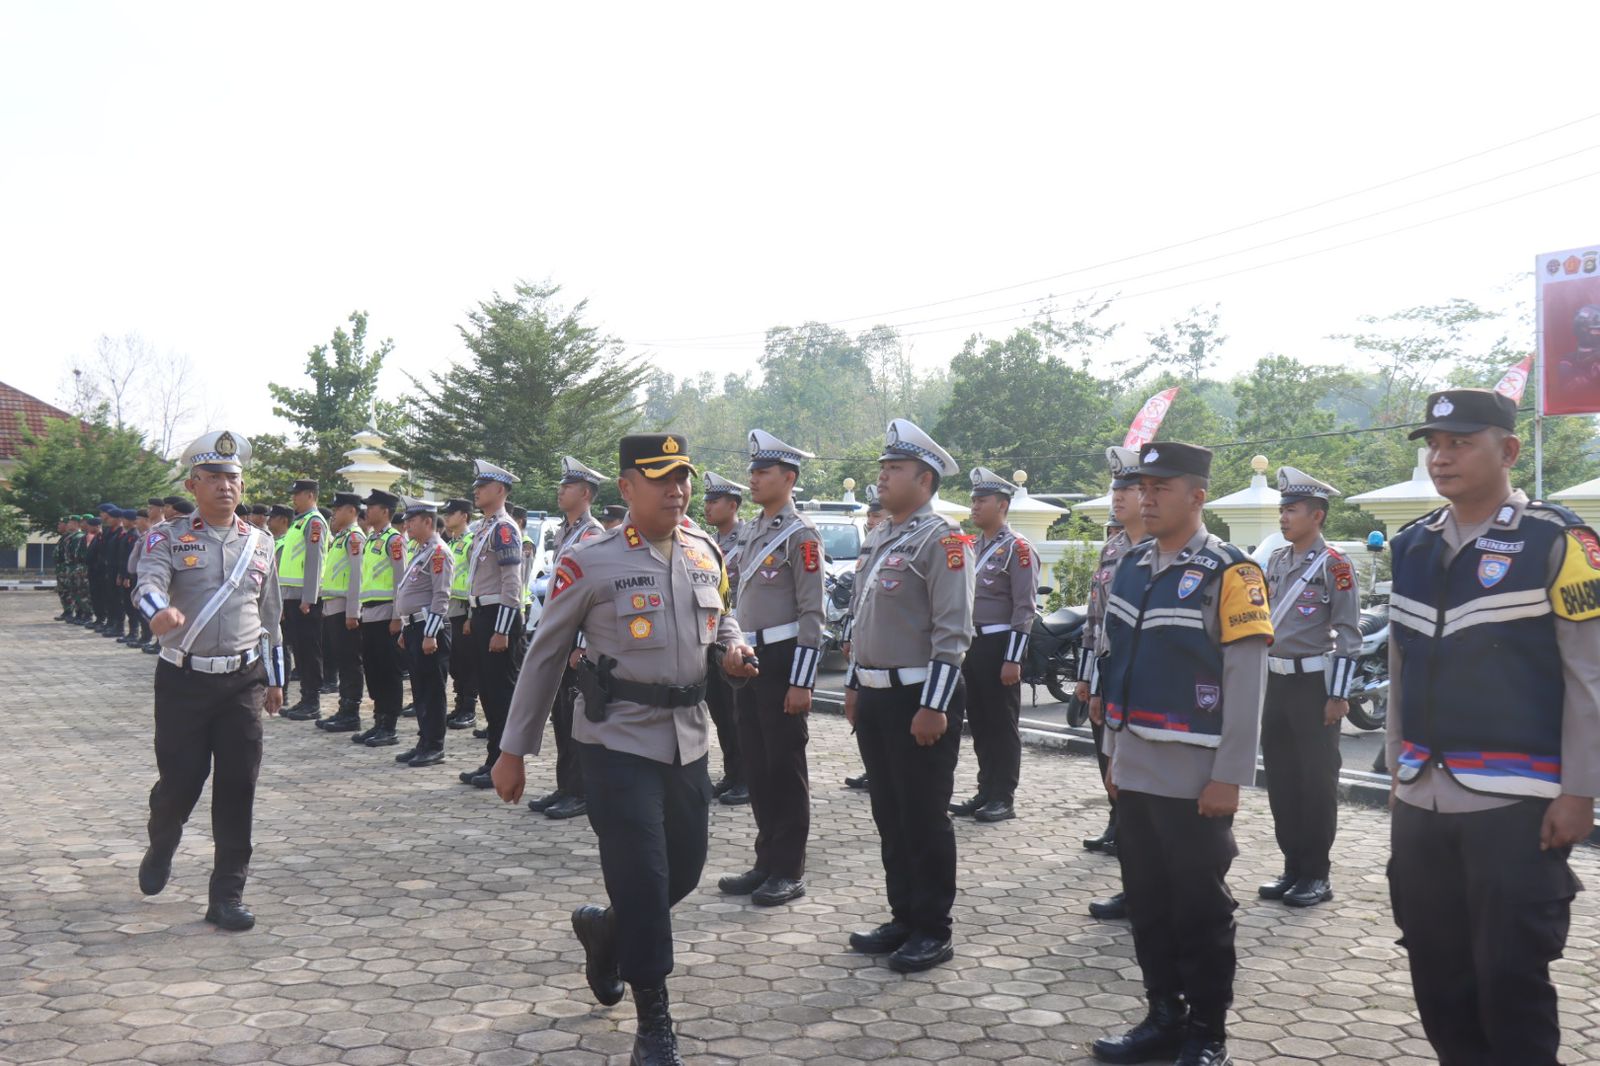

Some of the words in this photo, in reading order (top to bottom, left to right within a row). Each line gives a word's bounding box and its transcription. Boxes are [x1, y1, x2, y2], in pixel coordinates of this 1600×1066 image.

[172, 544, 206, 553] FADHLI
[1480, 540, 1522, 551] BINMAS
[614, 576, 655, 591] KHAIRU
